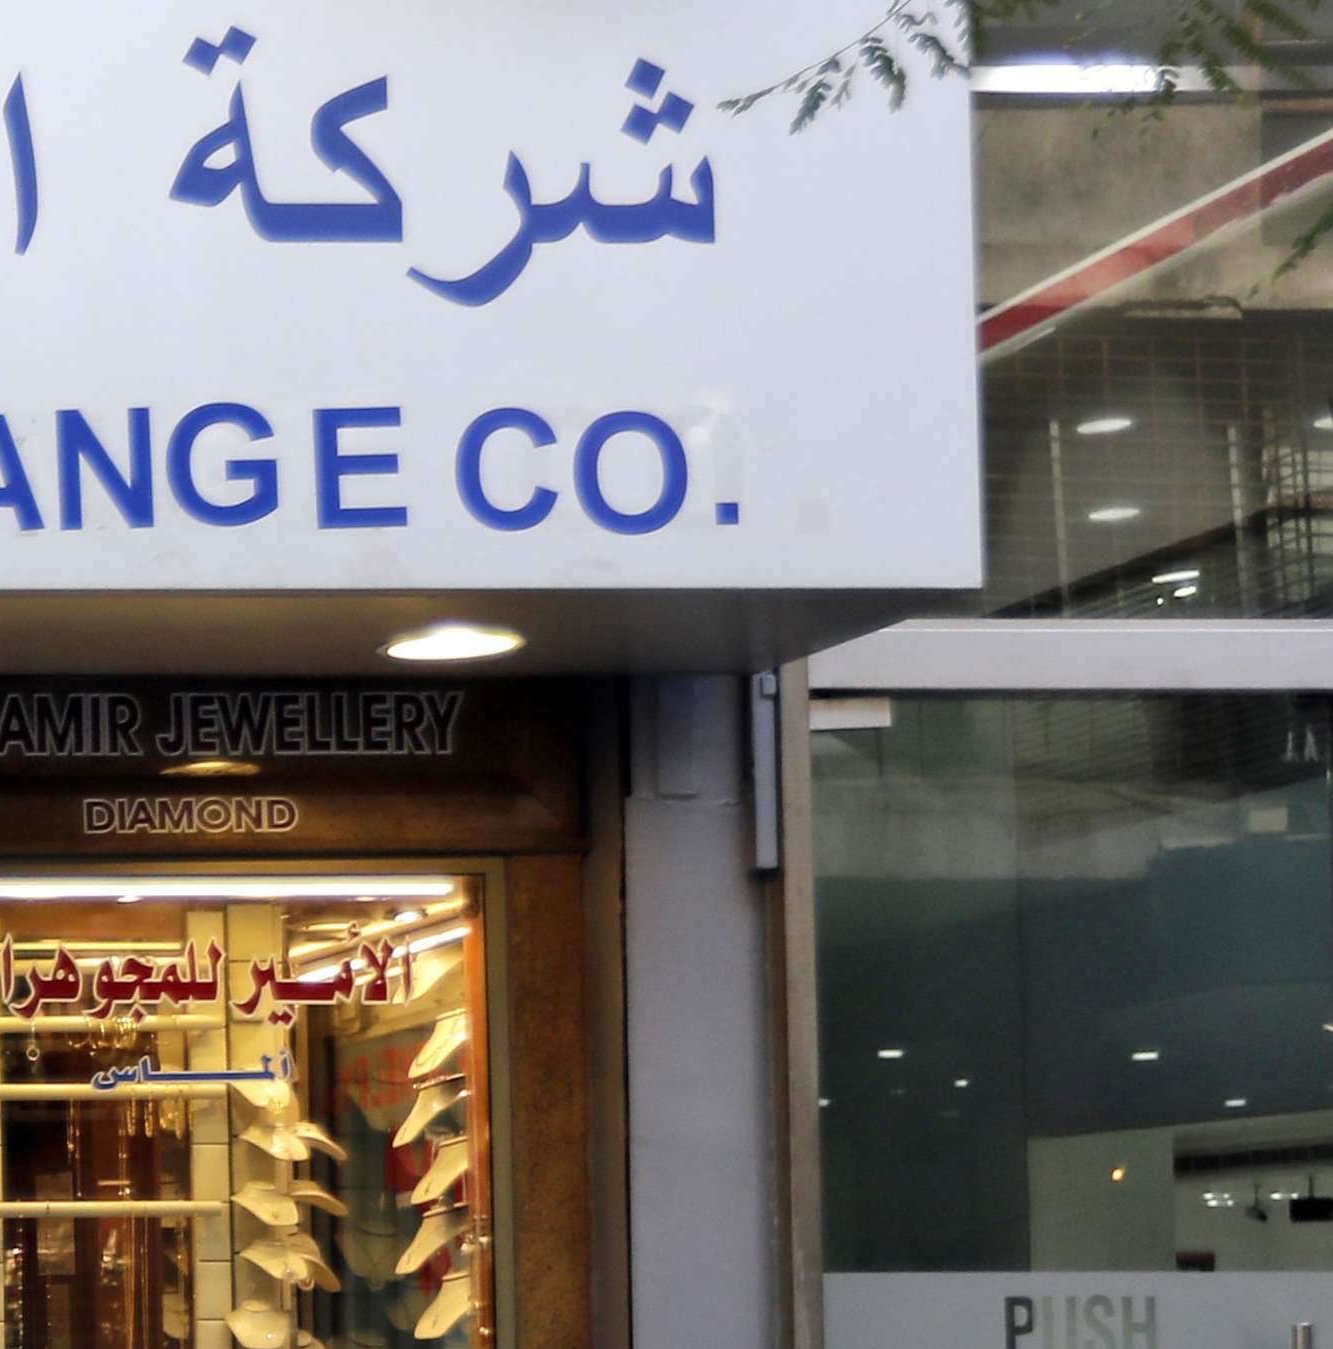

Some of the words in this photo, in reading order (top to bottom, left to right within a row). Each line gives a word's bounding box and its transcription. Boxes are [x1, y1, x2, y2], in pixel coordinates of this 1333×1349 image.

[170, 24, 716, 307] شركة
[454, 406, 741, 535] CO.
[155, 692, 464, 756] JEWELLERY
[83, 798, 299, 834] DIAMOND
[232, 920, 413, 1028] الأمير
